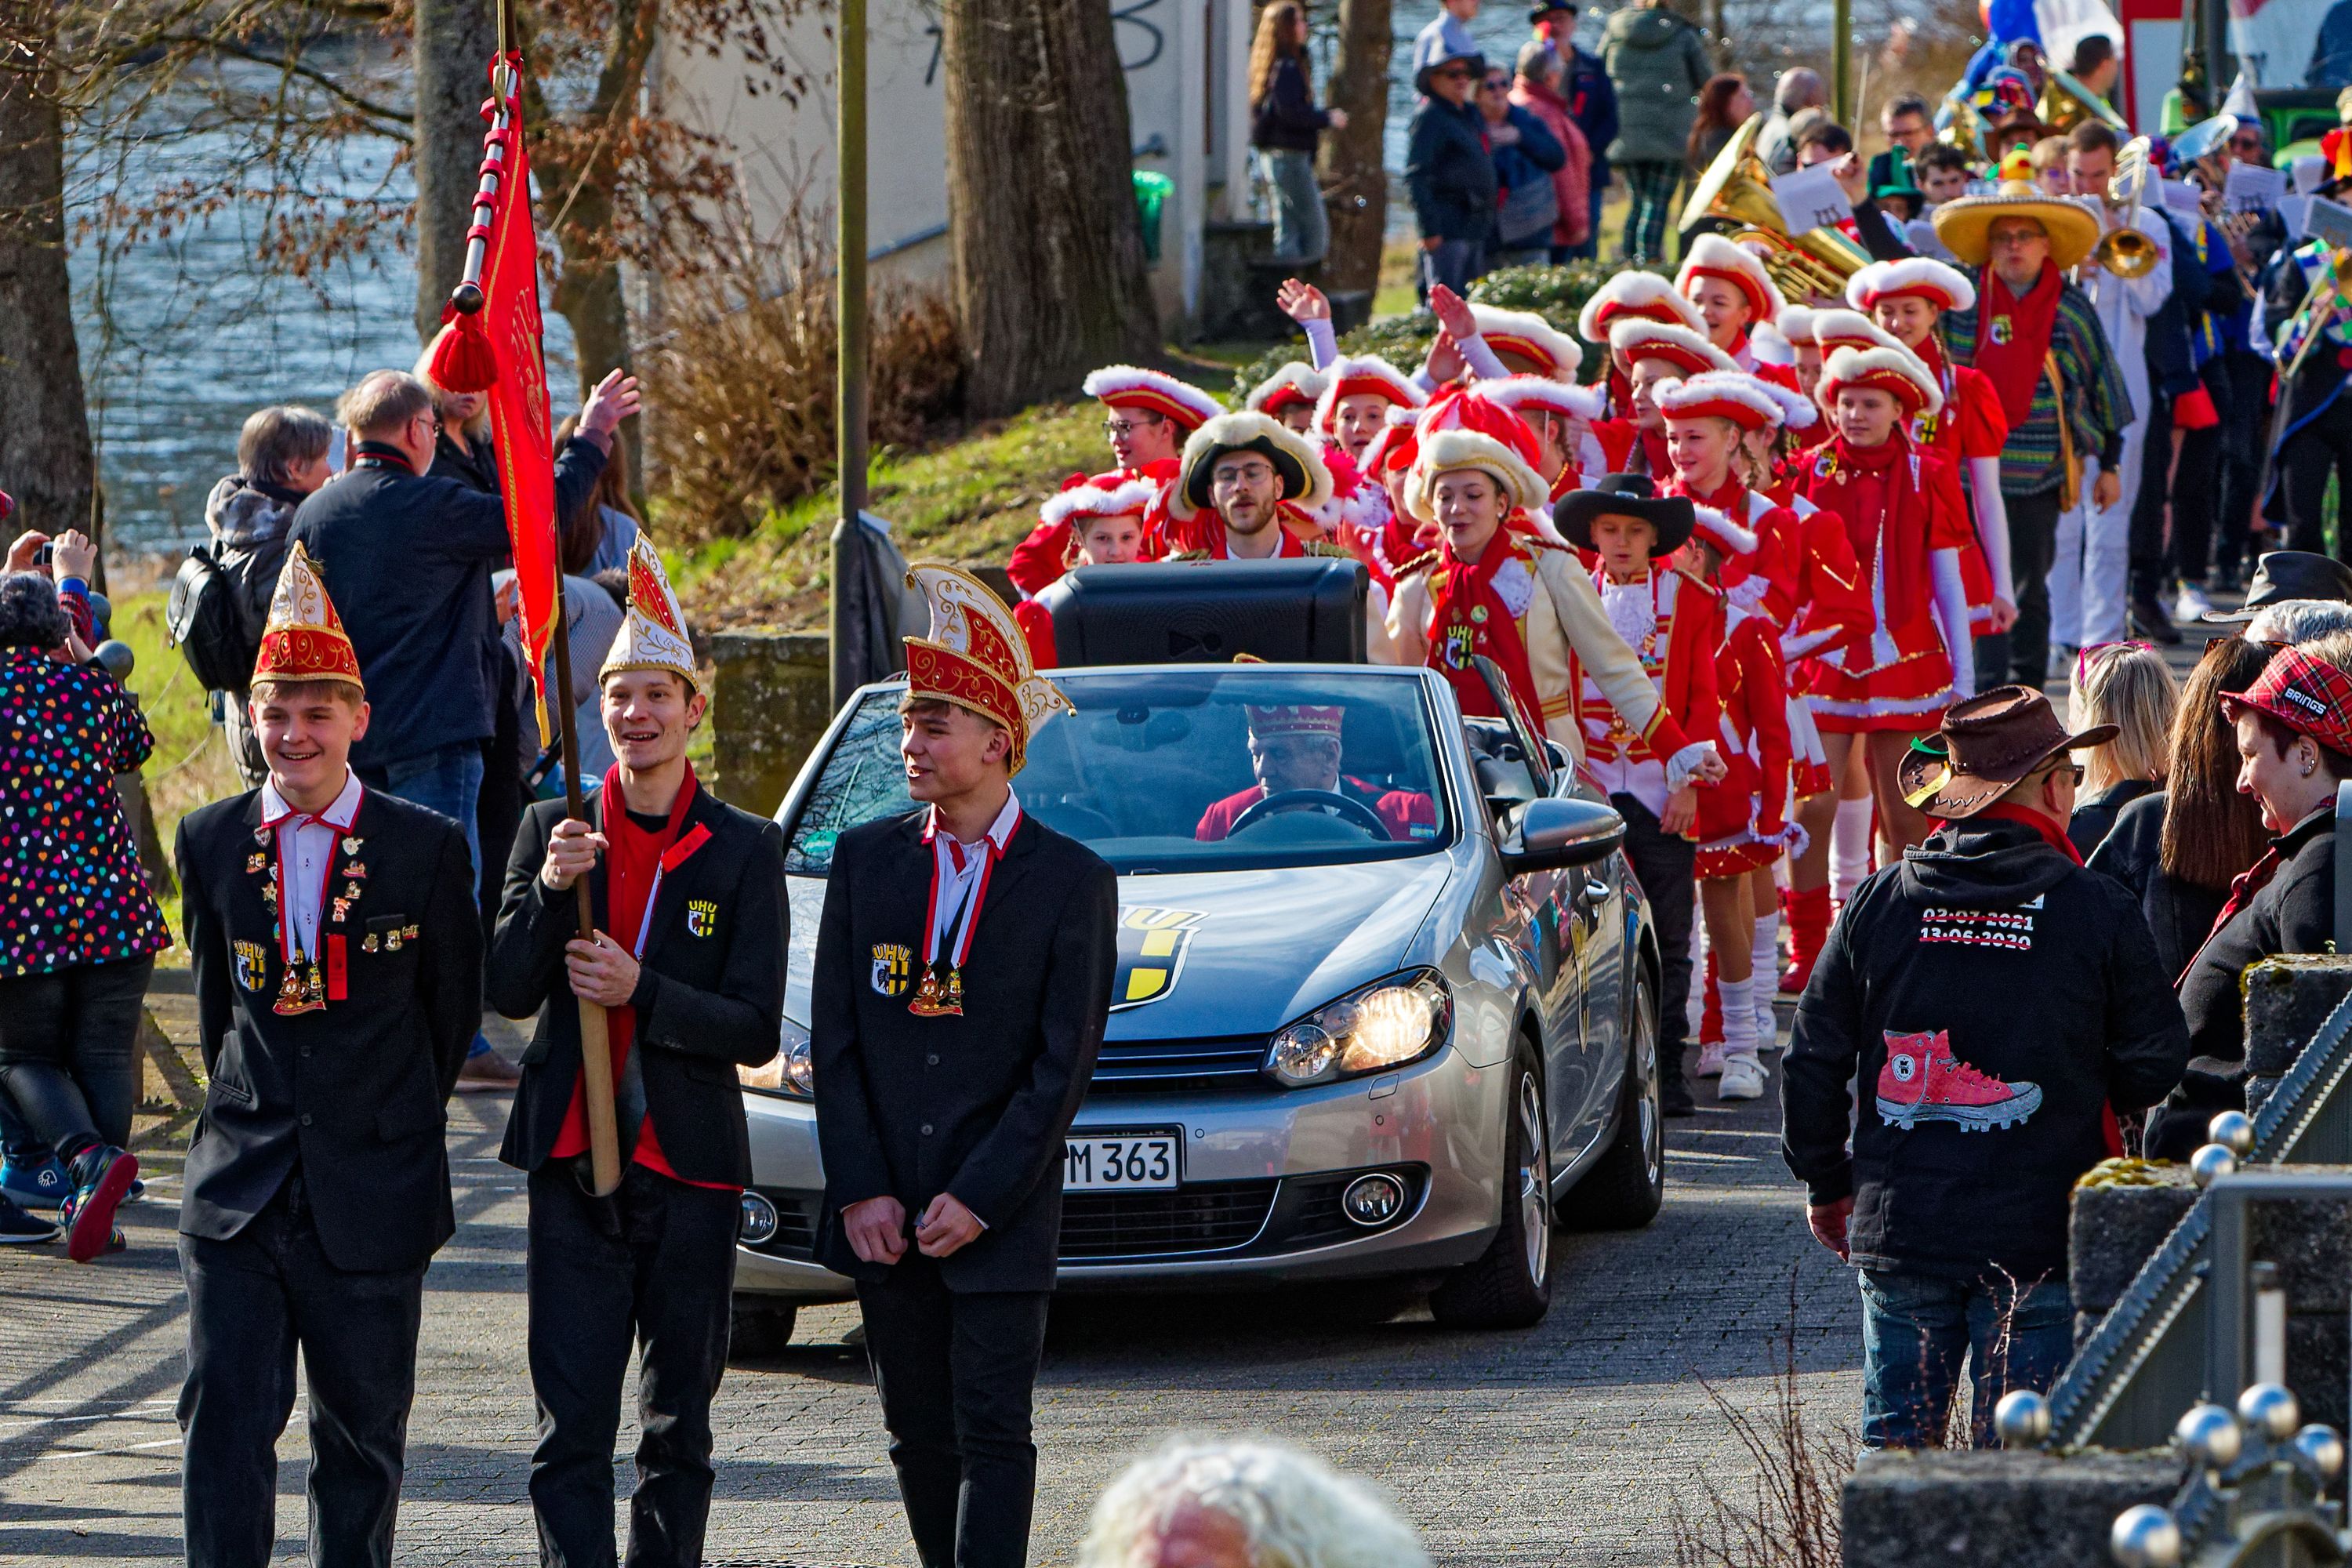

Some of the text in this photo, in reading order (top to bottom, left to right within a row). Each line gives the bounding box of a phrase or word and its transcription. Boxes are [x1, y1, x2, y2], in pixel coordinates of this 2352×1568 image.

[2285, 688, 2327, 715] BRINGS
[689, 900, 717, 913] UHU
[1120, 907, 1194, 930] U
[234, 940, 265, 960] UHU
[873, 943, 911, 962] UHU
[1102, 1142, 1170, 1182] 363
